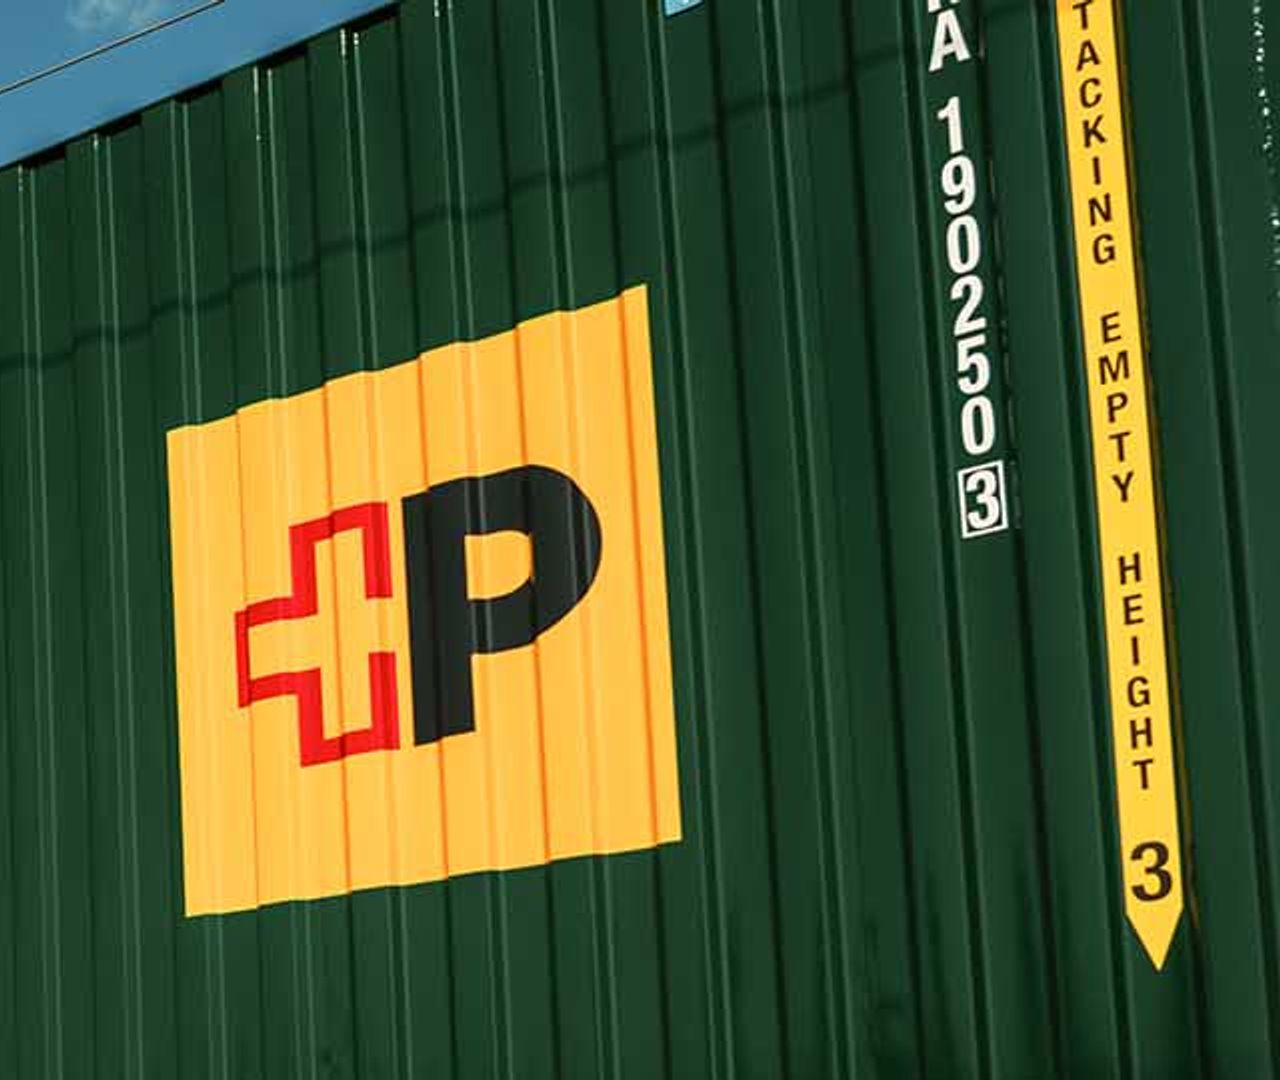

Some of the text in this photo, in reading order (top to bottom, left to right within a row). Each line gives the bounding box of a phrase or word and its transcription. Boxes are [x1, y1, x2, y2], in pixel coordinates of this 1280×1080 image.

[937, 96, 997, 456] 190250
[963, 467, 1001, 531] 3
[1098, 311, 1134, 503] EMPTY
[1118, 552, 1153, 790] HEIGHT
[1130, 841, 1172, 902] 3
